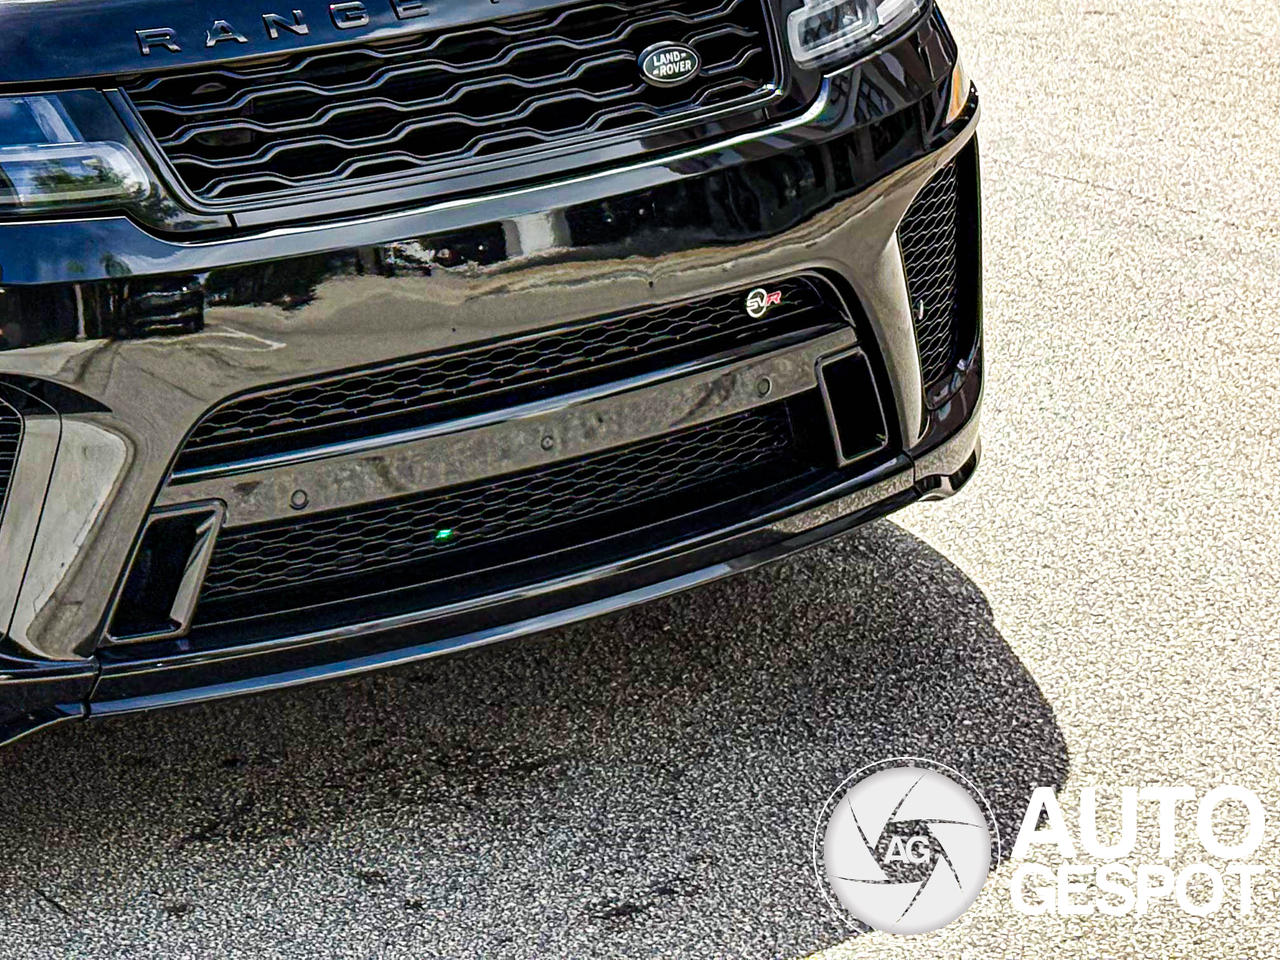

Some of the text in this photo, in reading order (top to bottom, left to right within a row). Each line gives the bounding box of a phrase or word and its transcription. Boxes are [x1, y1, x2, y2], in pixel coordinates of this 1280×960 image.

[653, 51, 681, 67] LAND
[659, 60, 692, 77] ROVER
[746, 289, 782, 315] SVR
